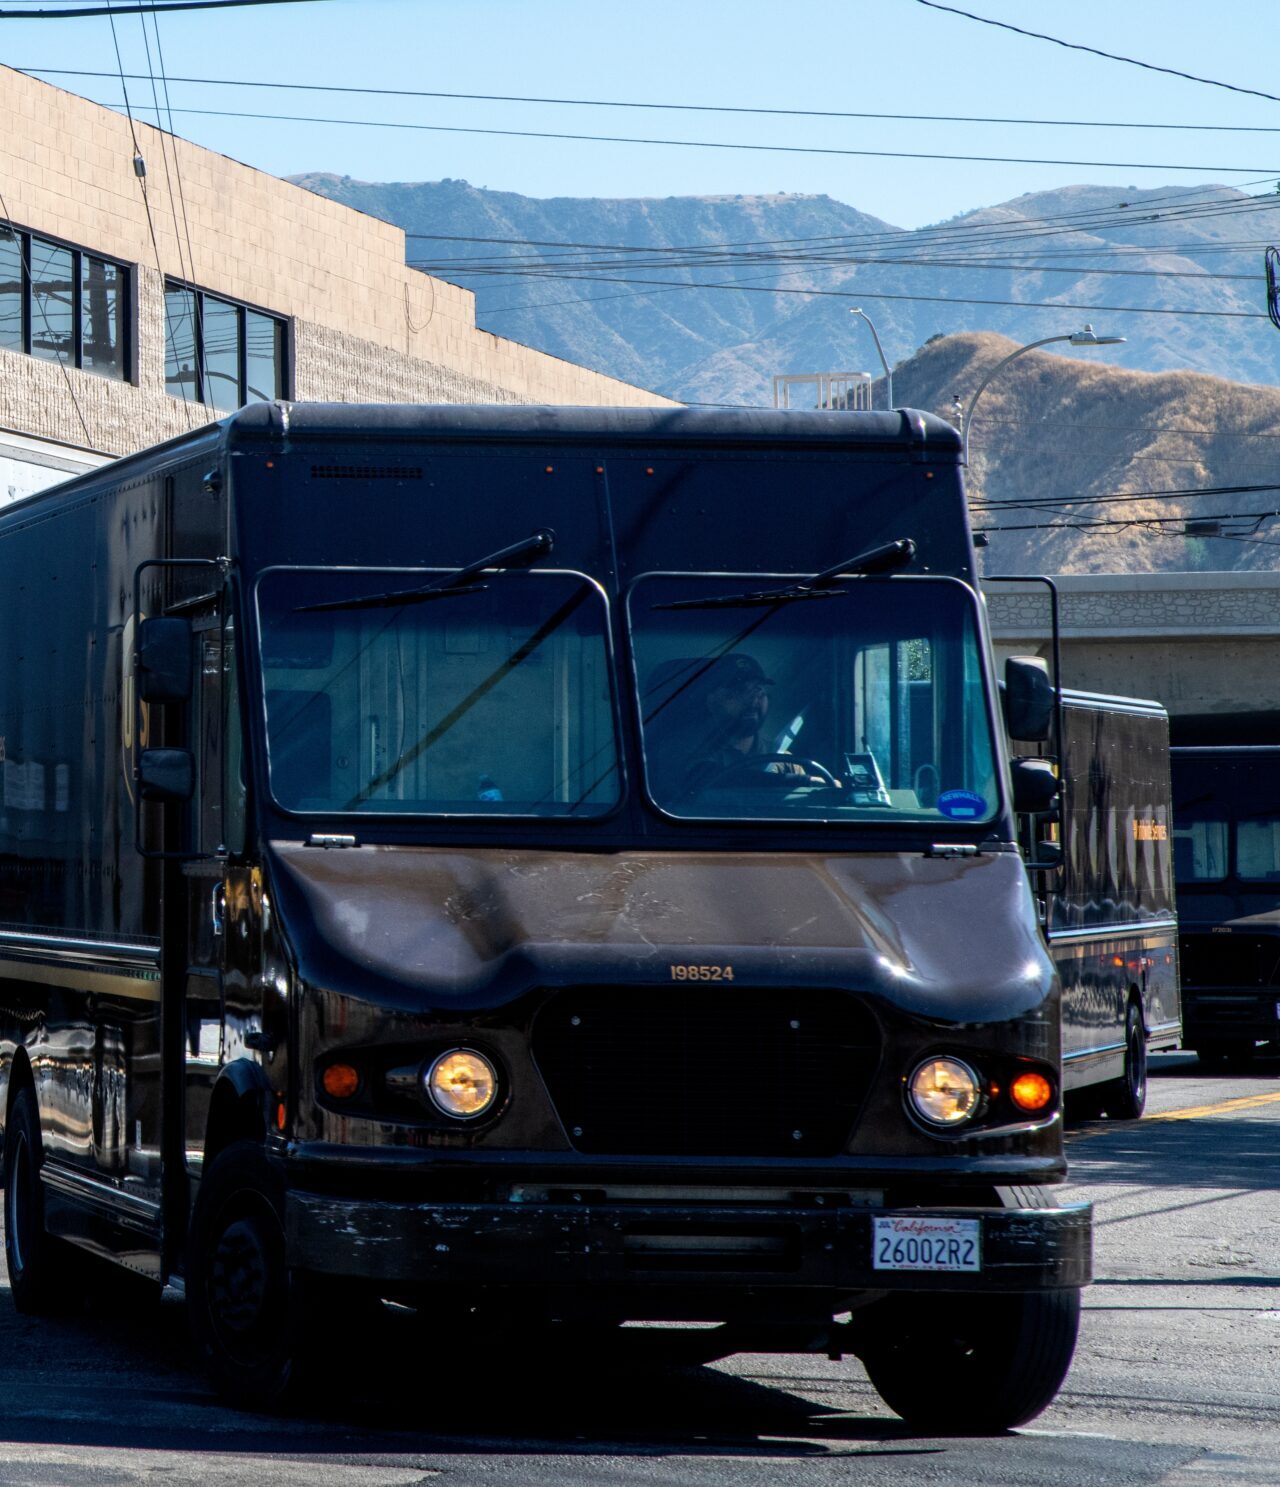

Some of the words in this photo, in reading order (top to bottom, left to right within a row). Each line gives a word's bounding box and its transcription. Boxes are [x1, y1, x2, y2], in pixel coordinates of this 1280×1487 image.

[941, 792, 982, 804] NEWHALL
[671, 965, 736, 981] 198524
[893, 1220, 961, 1236] California
[879, 1238, 975, 1265] 26002R2
